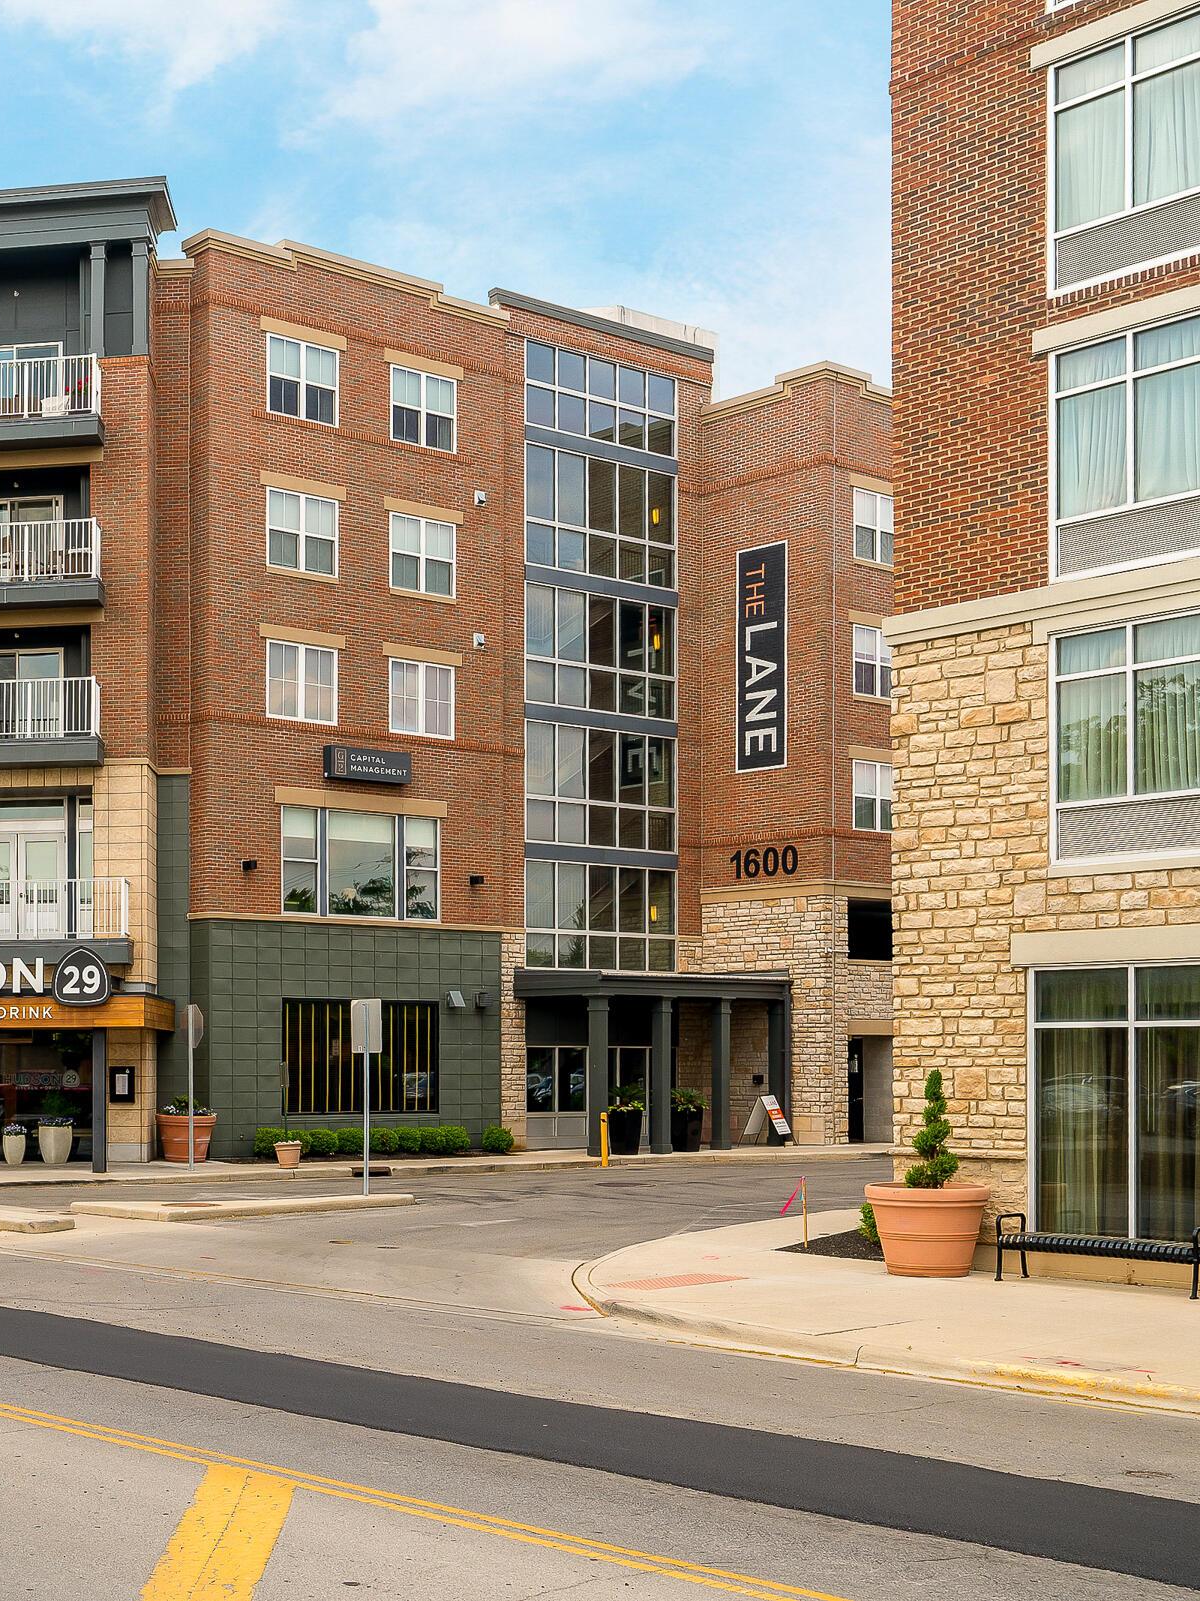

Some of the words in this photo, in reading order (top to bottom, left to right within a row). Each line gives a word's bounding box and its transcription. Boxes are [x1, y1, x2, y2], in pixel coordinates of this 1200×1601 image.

[744, 562, 766, 617] THE
[744, 620, 778, 758] LANE
[337, 751, 345, 760] G
[350, 754, 386, 764] CAPITAL
[350, 765, 407, 777] MANAGEMENT
[729, 844, 799, 879] 1600
[61, 965, 101, 995] 29
[2, 1073, 63, 1086] HUDSON
[66, 1074, 77, 1084] 29
